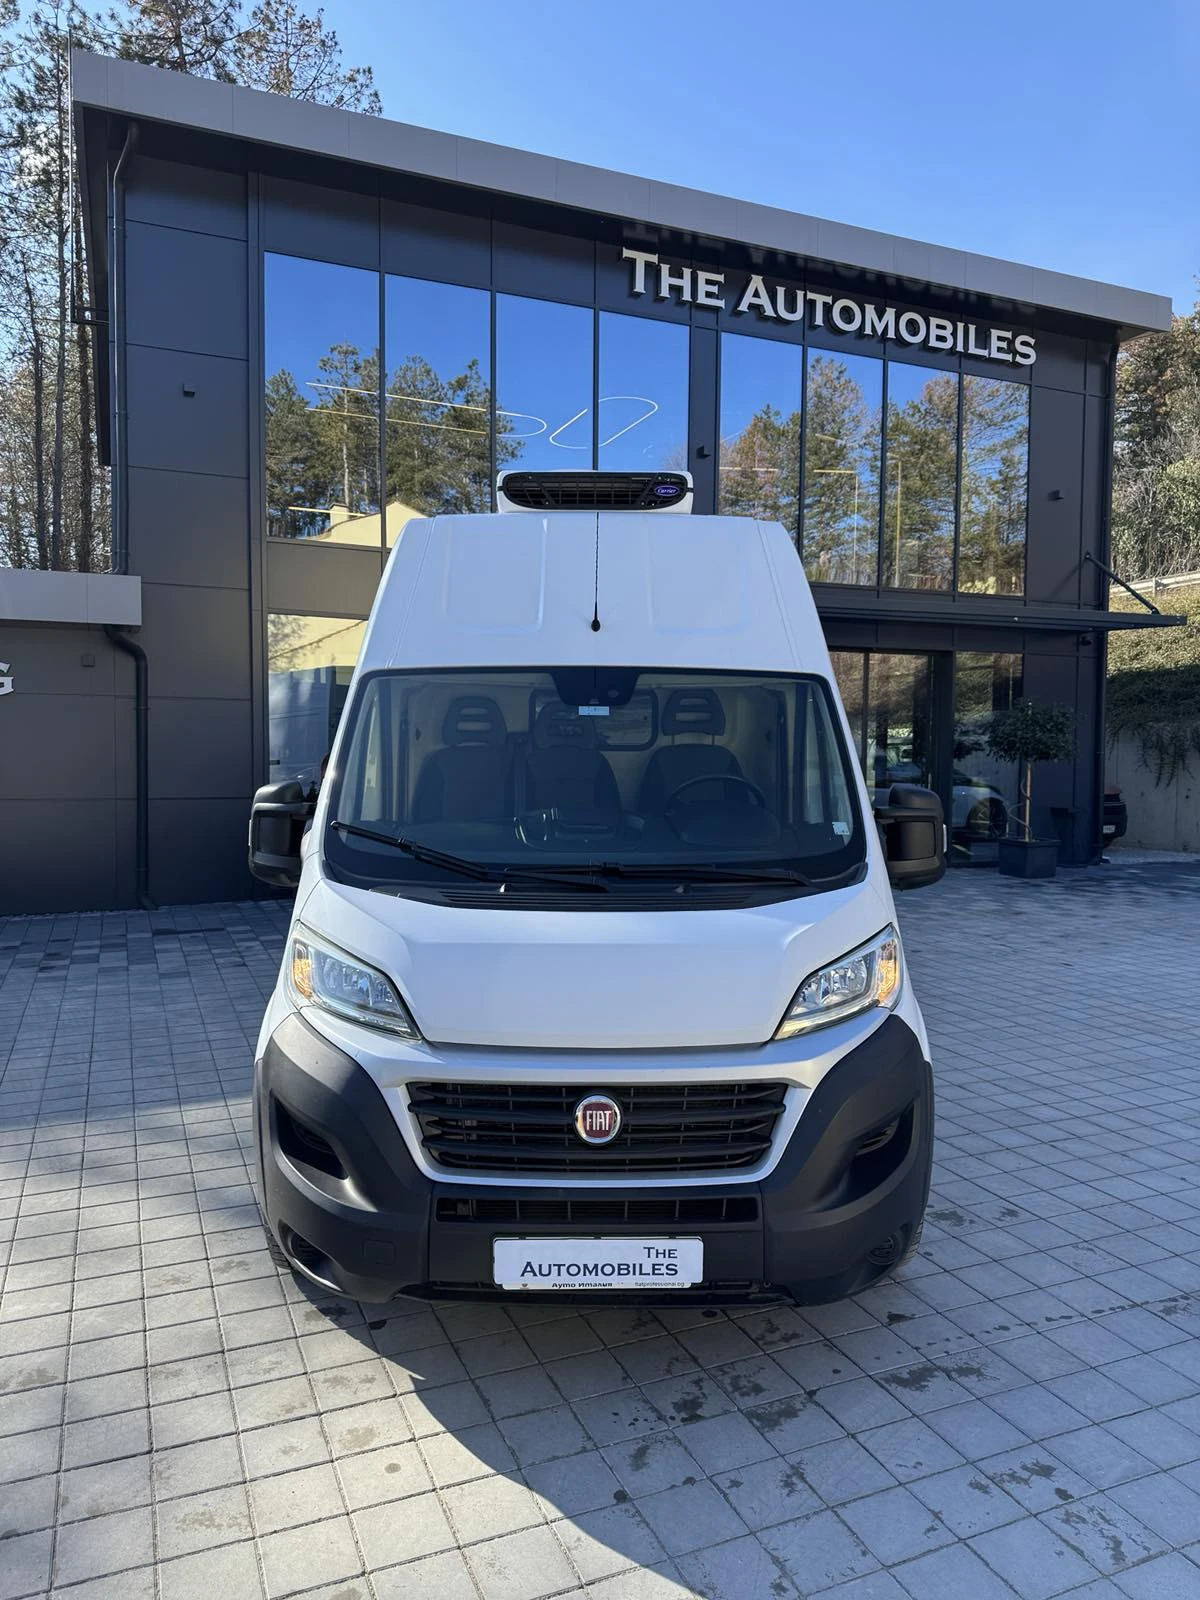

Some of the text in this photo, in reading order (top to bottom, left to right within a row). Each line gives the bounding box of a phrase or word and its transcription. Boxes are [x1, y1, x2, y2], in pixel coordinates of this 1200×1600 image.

[622, 246, 1037, 366] THE AUTOMOBILES
[586, 1110, 612, 1131] FIAT
[643, 1247, 678, 1259] THE
[520, 1261, 678, 1277] AUTOMOBILES
